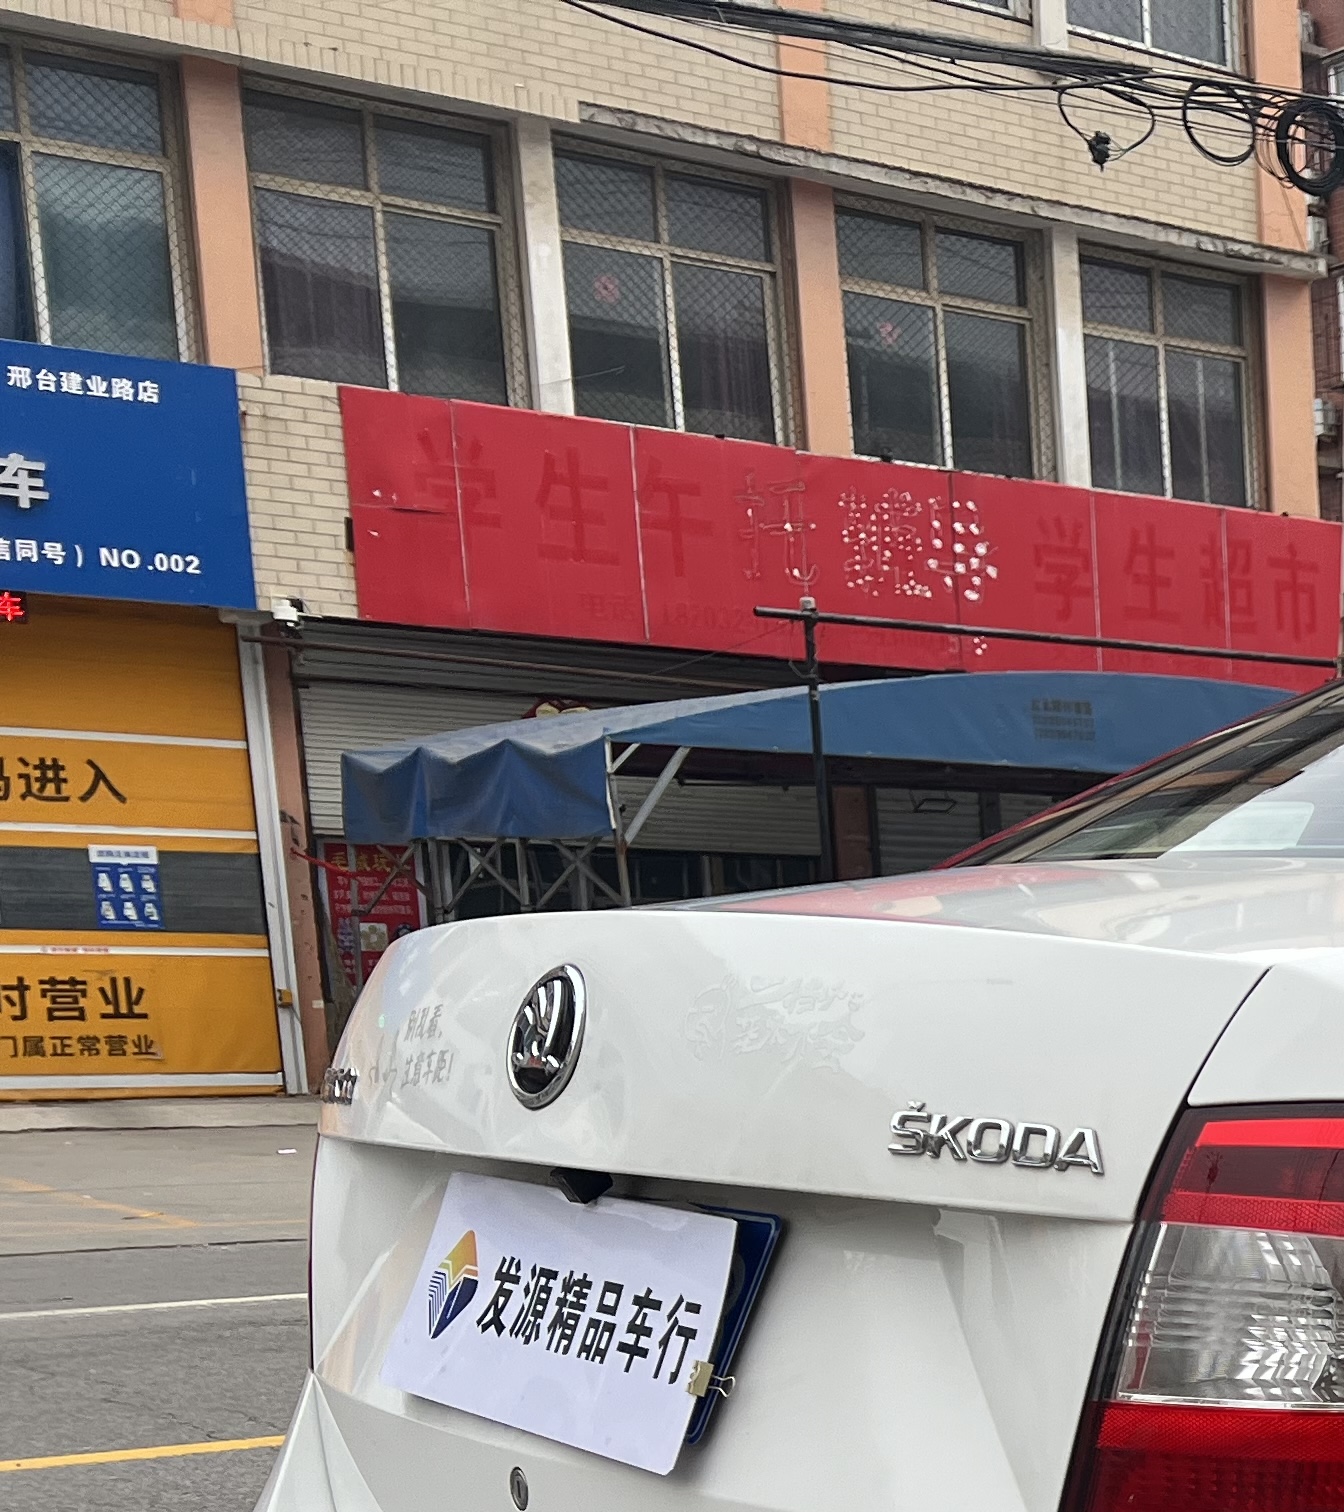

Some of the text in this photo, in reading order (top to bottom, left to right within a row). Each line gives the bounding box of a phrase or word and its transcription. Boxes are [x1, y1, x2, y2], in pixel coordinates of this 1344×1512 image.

[7, 365, 160, 404] 邢台建业路店
[0, 755, 127, 804] 进入
[474, 1254, 704, 1386] 发源精品车行
